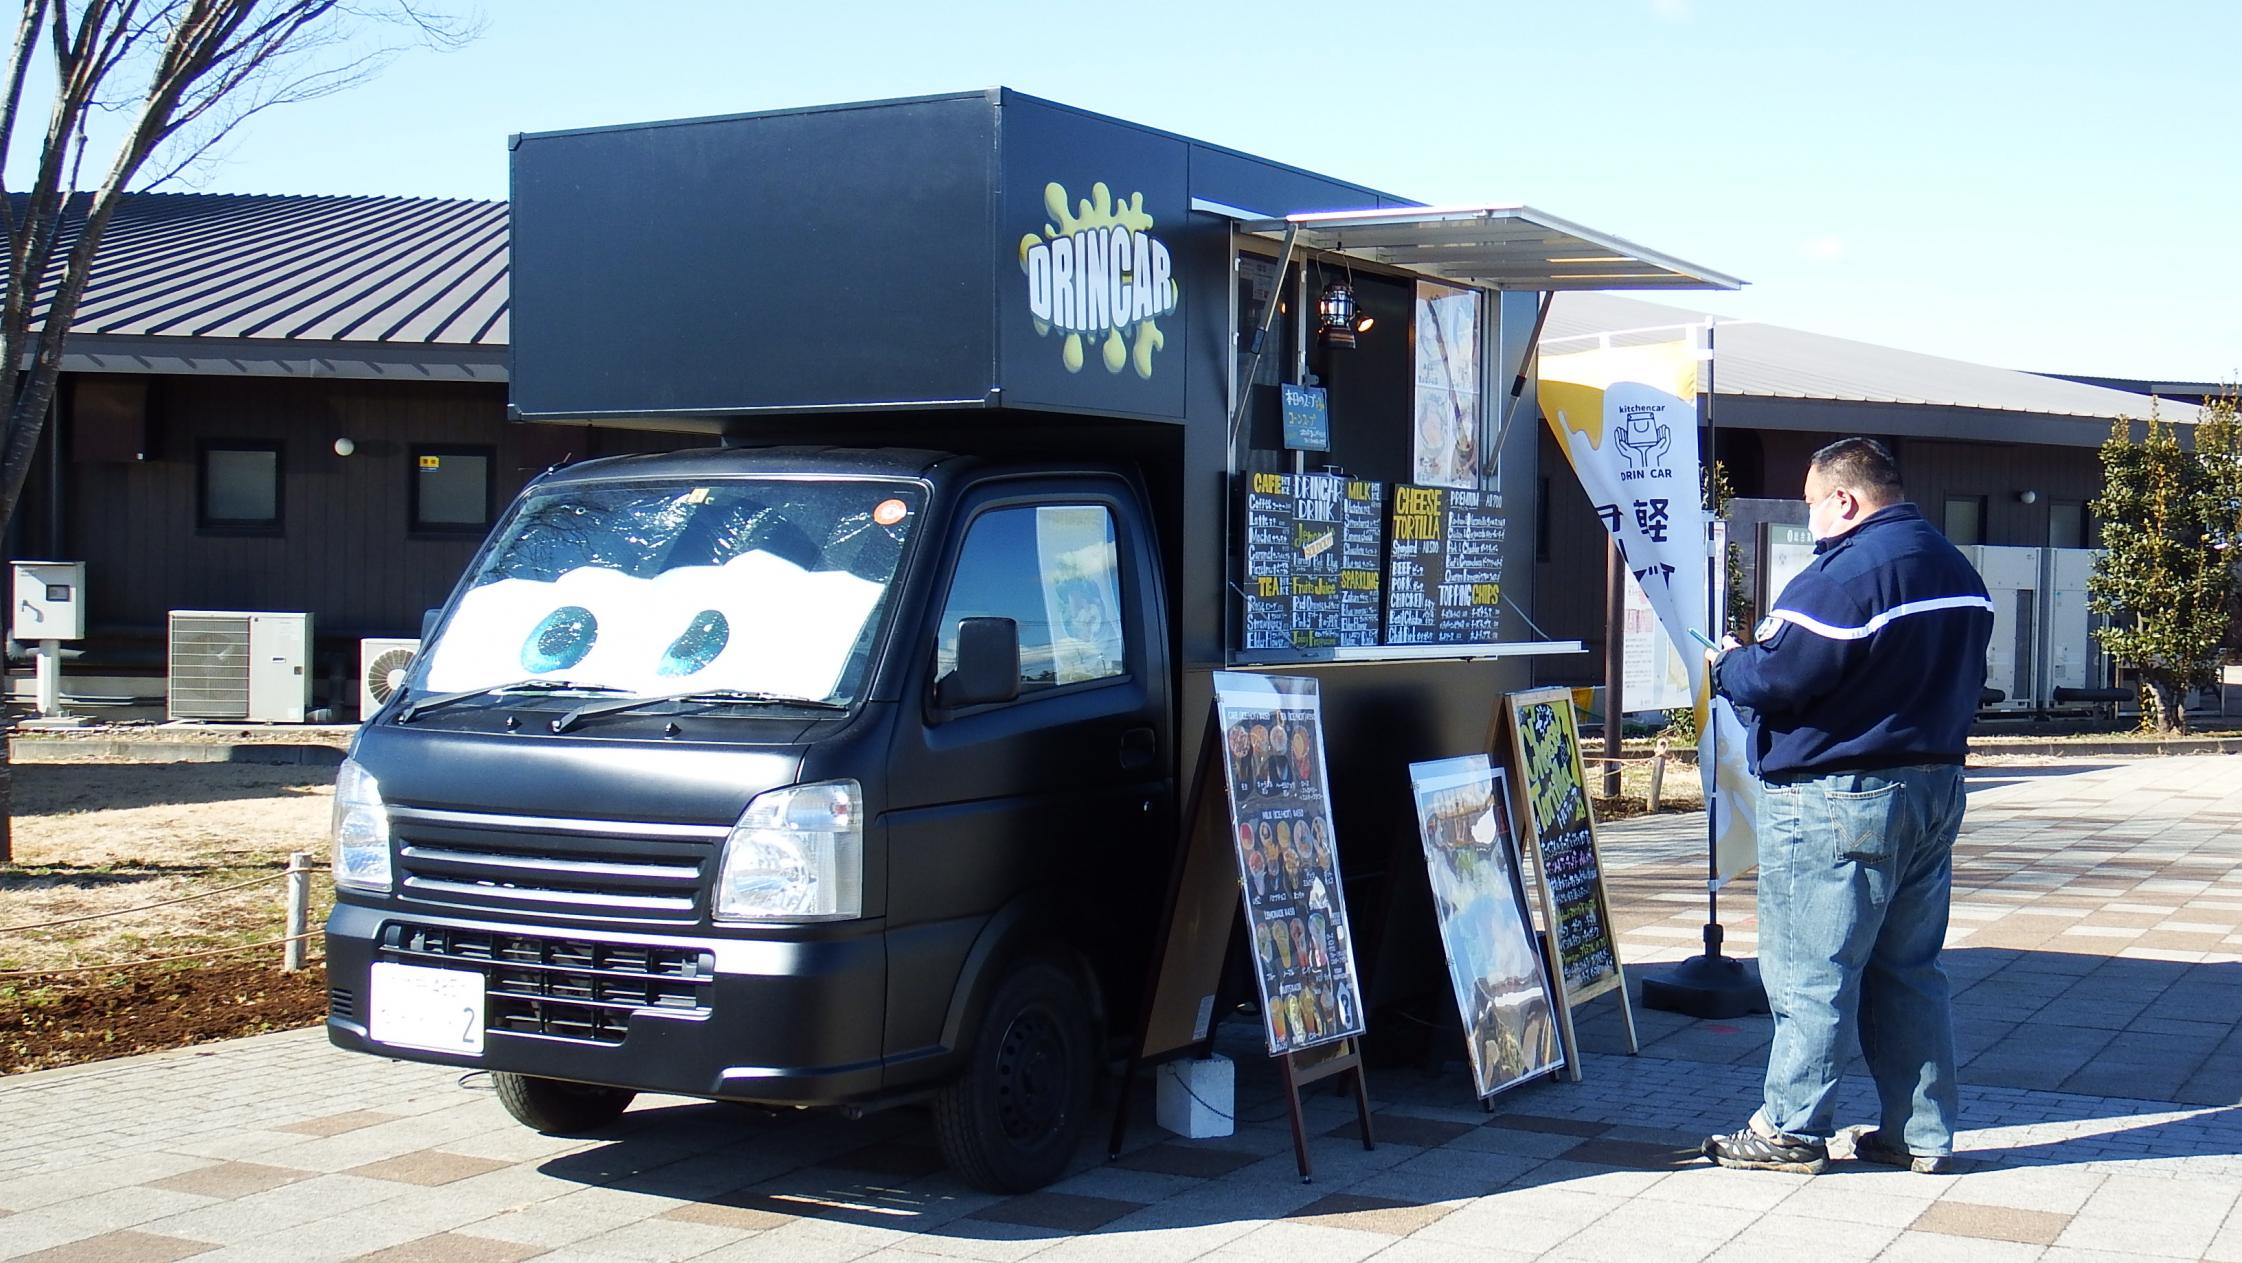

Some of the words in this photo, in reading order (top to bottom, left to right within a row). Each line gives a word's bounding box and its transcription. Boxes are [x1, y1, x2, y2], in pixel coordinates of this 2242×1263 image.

[1029, 226, 1172, 331] DRINCAR
[1619, 404, 1666, 414] kitchencar
[1253, 473, 1281, 494] CAFE
[1621, 470, 1645, 481] DRIN
[1650, 469, 1673, 479] CAR
[1294, 475, 1343, 503] DRINCAR
[1348, 481, 1371, 501] MILK
[1450, 490, 1479, 507] PREMIUM
[1298, 499, 1335, 521] DRINK
[1396, 486, 1443, 516] CHEESE
[1393, 514, 1440, 540] TORTILLA
[1392, 560, 1412, 576] BEEF
[1258, 577, 1280, 597] TEA
[1341, 569, 1379, 590] SPARKLING
[1391, 575, 1413, 592] PORK
[1390, 592, 1424, 609] CHICKEN
[1438, 583, 1472, 607] TOPPING
[1471, 583, 1500, 605] CHIPS
[463, 1007, 475, 1043] 2
